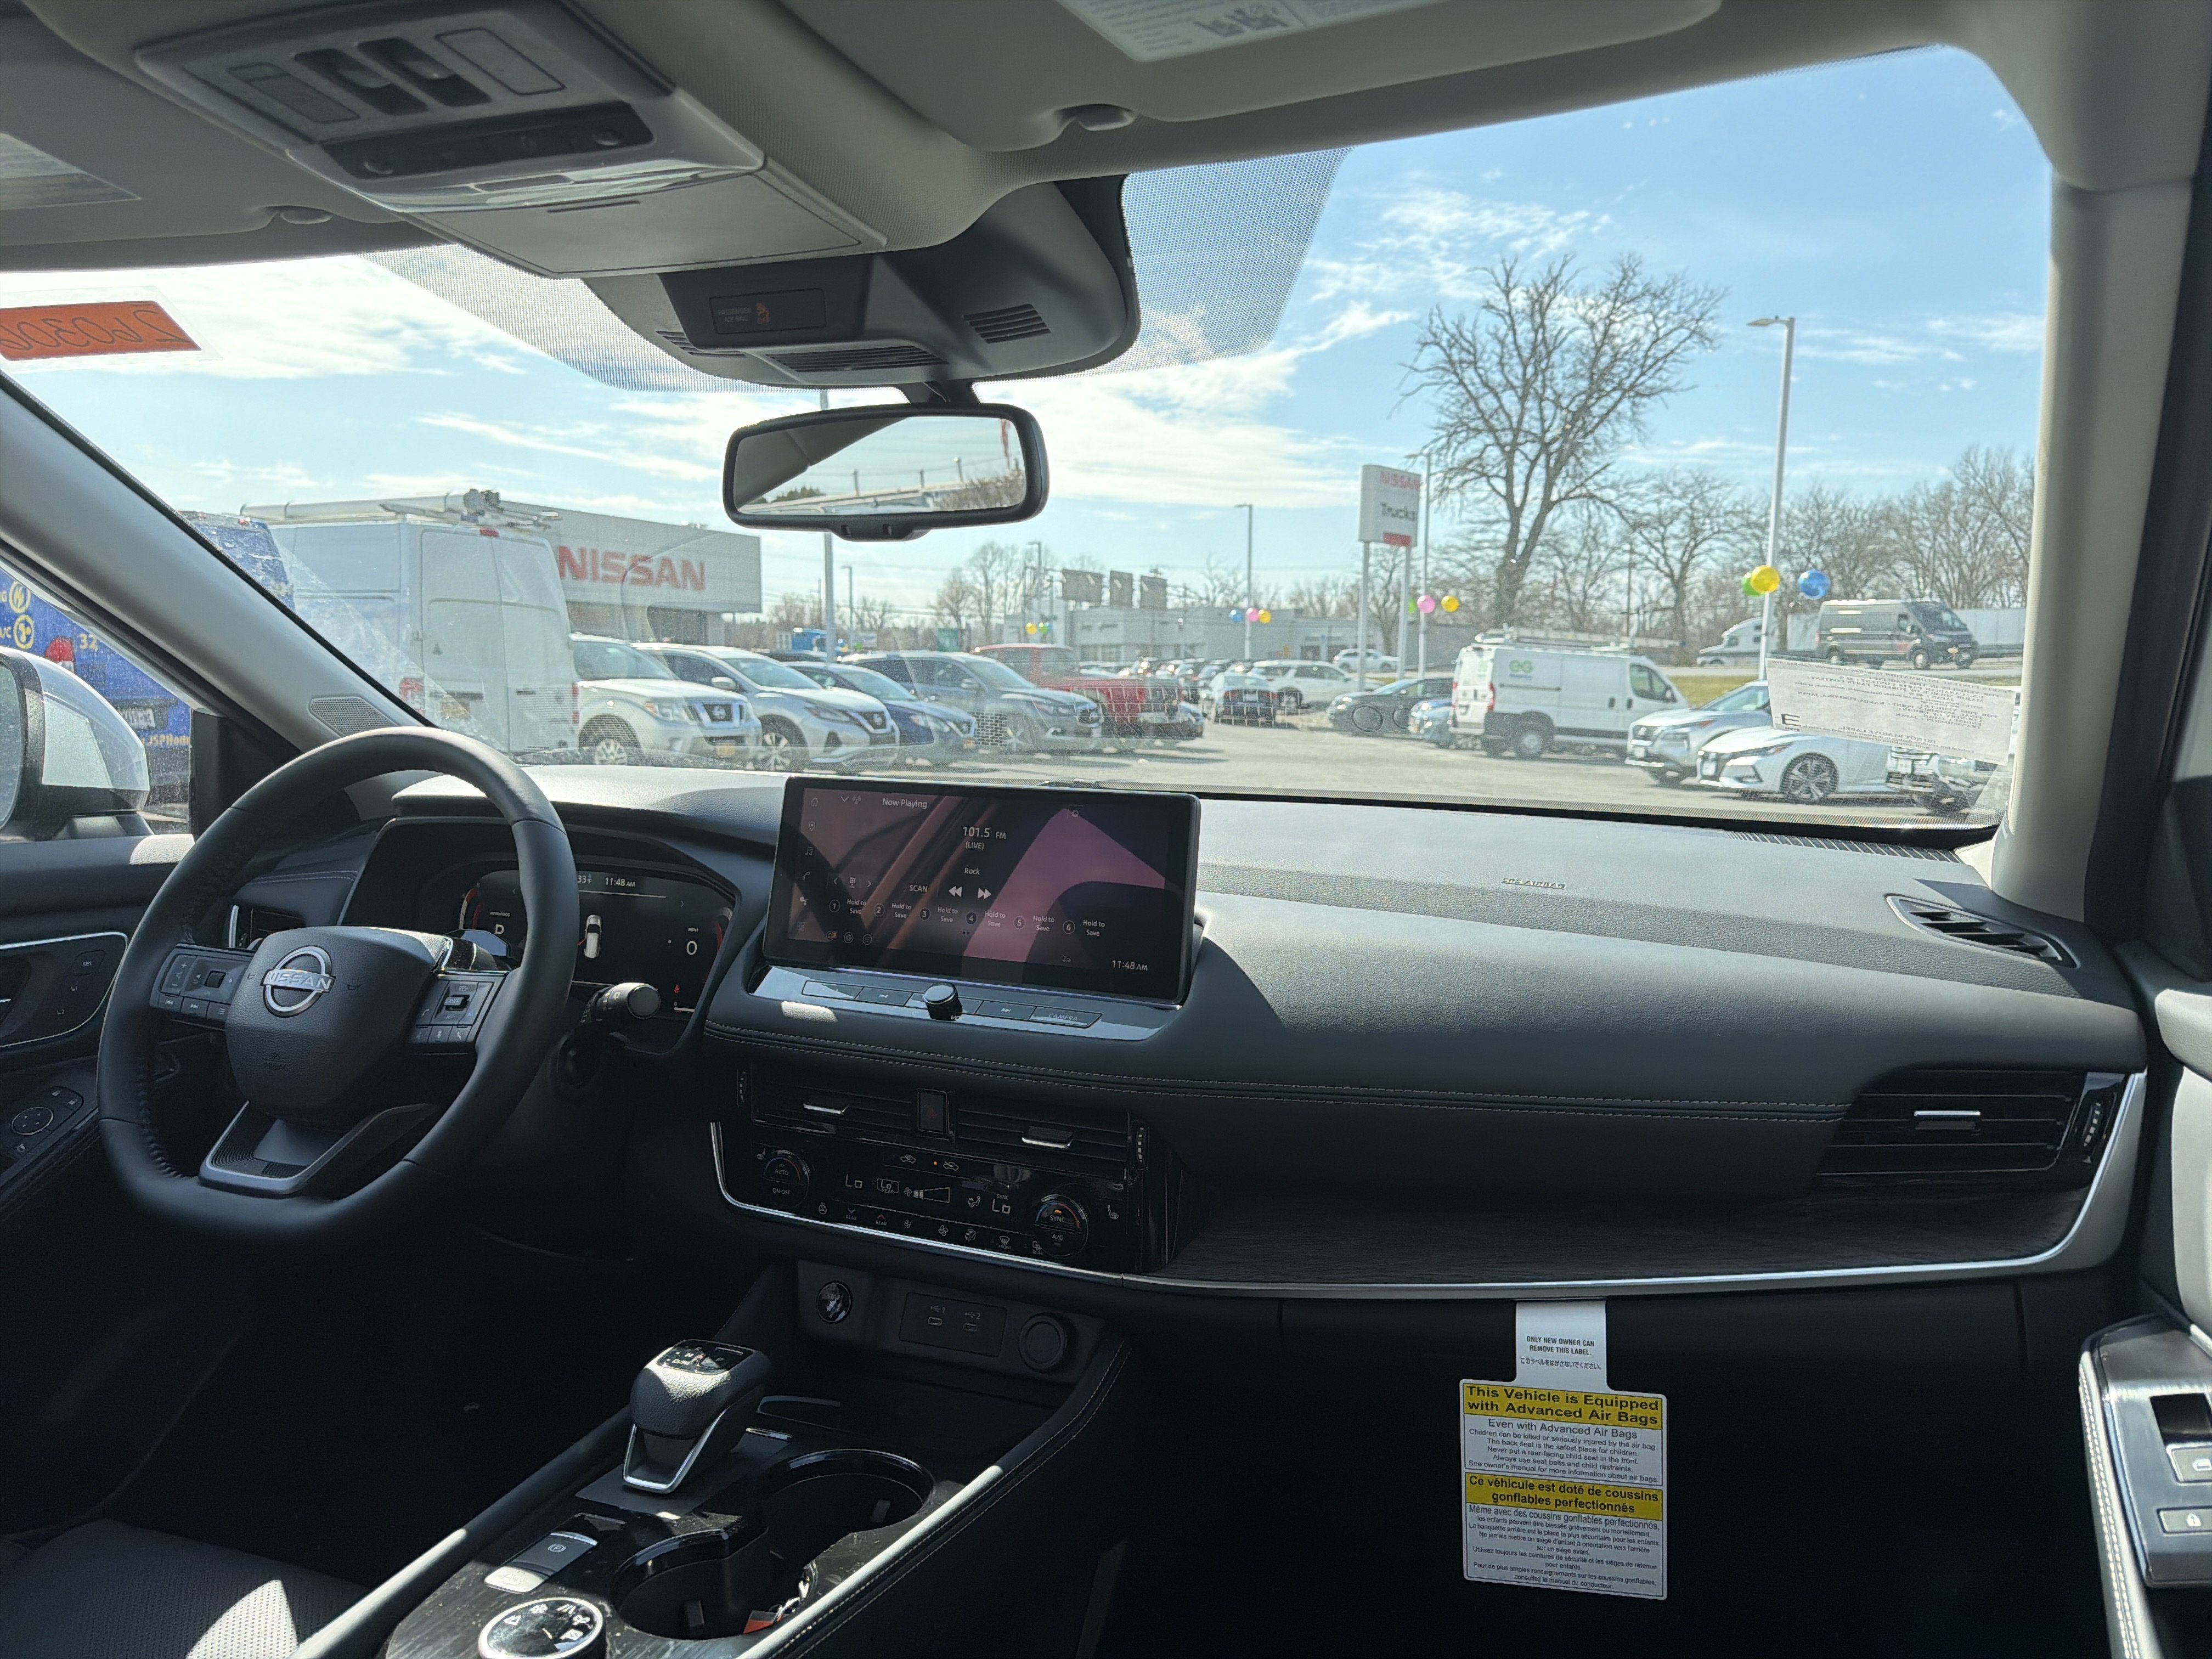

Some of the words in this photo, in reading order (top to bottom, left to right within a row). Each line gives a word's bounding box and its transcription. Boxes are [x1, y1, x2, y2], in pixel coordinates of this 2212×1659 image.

[557, 545, 706, 591] NISSAN
[882, 798, 899, 807] Now
[901, 799, 927, 810] Playing
[962, 827, 991, 838] 101.5
[966, 842, 984, 850] (LIVE)
[605, 877, 625, 887] 11:48
[494, 924, 505, 935] D
[686, 940, 698, 956] 0
[1111, 960, 1135, 970] 11:48
[267, 973, 332, 990] NISSAN
[1048, 1013, 1078, 1022] CAMERA
[1466, 1385, 1499, 1398] This
[1503, 1387, 1560, 1403] Vehicle
[1565, 1393, 1578, 1404] is
[1583, 1394, 1659, 1412] Equipped
[1467, 1400, 1499, 1412] with
[1505, 1402, 1582, 1419] Advanced
[1588, 1409, 1612, 1421] Air
[1617, 1410, 1658, 1426] Bags
[1488, 1418, 1514, 1429] Even
[1516, 1421, 1537, 1431] with
[1539, 1423, 1591, 1435] Advanced
[1593, 1427, 1609, 1437] Air
[1611, 1428, 1638, 1441] Bags
[1469, 1428, 1498, 1437] Children
[1498, 1430, 1511, 1438] can
[1522, 1432, 1541, 1441] killed
[1550, 1436, 1582, 1446] seriously
[1583, 1437, 1607, 1446] injured
[1607, 1440, 1617, 1448] by
[1501, 1438, 1519, 1447] back
[1555, 1443, 1577, 1452] safest
[1578, 1445, 1598, 1453] place
[1487, 1445, 1508, 1454] Never
[1527, 1450, 1565, 1460] rear-facing
[1565, 1452, 1582, 1460] child
[1468, 1459, 1483, 1468] See
[1567, 1468, 1606, 1478] information
[1607, 1472, 1628, 1480] about
[1469, 1475, 1485, 1486] Ce
[1487, 1477, 1536, 1491] véhicule
[1538, 1481, 1556, 1493] est
[1558, 1482, 1584, 1495] doté
[1587, 1485, 1602, 1497] de
[1605, 1489, 1659, 1502] coussins
[1492, 1492, 1551, 1506] gonflables
[1554, 1498, 1635, 1514] perfectionnés
[1469, 1504, 1493, 1516] Même
[1493, 1508, 1512, 1518] avec
[1513, 1508, 1527, 1518] des
[1528, 1511, 1562, 1522] coussins
[1563, 1514, 1603, 1525] gonflables
